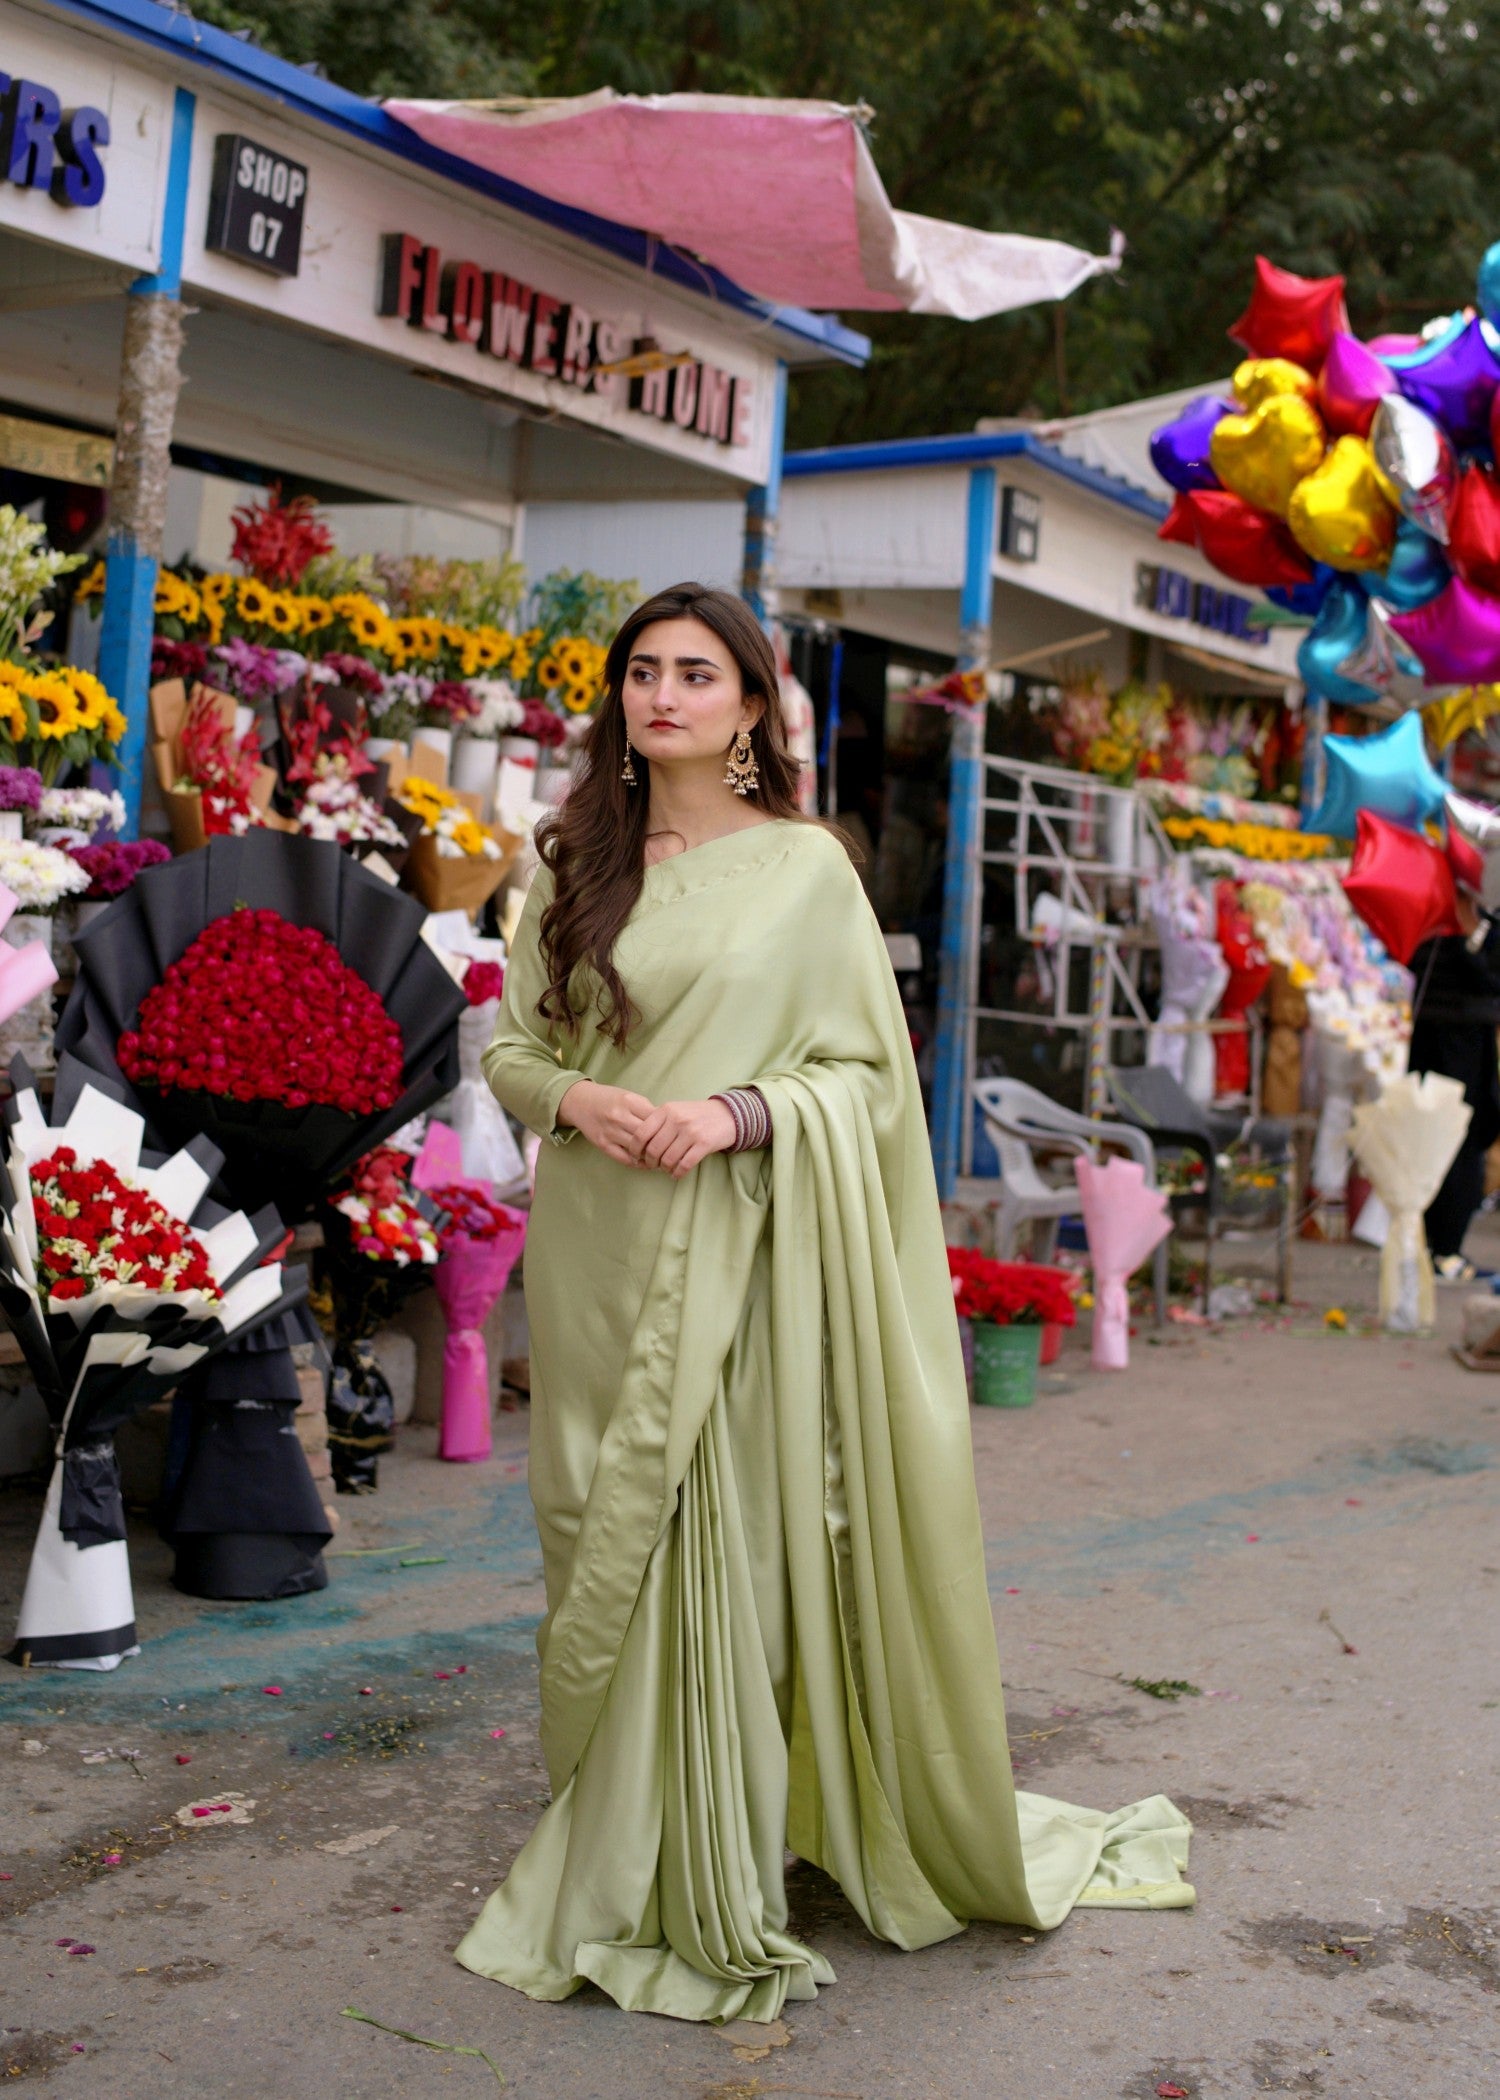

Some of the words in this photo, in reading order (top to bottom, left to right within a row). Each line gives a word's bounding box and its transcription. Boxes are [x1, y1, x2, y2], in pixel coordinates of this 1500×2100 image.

[0, 71, 110, 208] RS
[237, 145, 305, 209] SHOP
[249, 211, 283, 259] 07
[398, 233, 623, 397] FLOWERS
